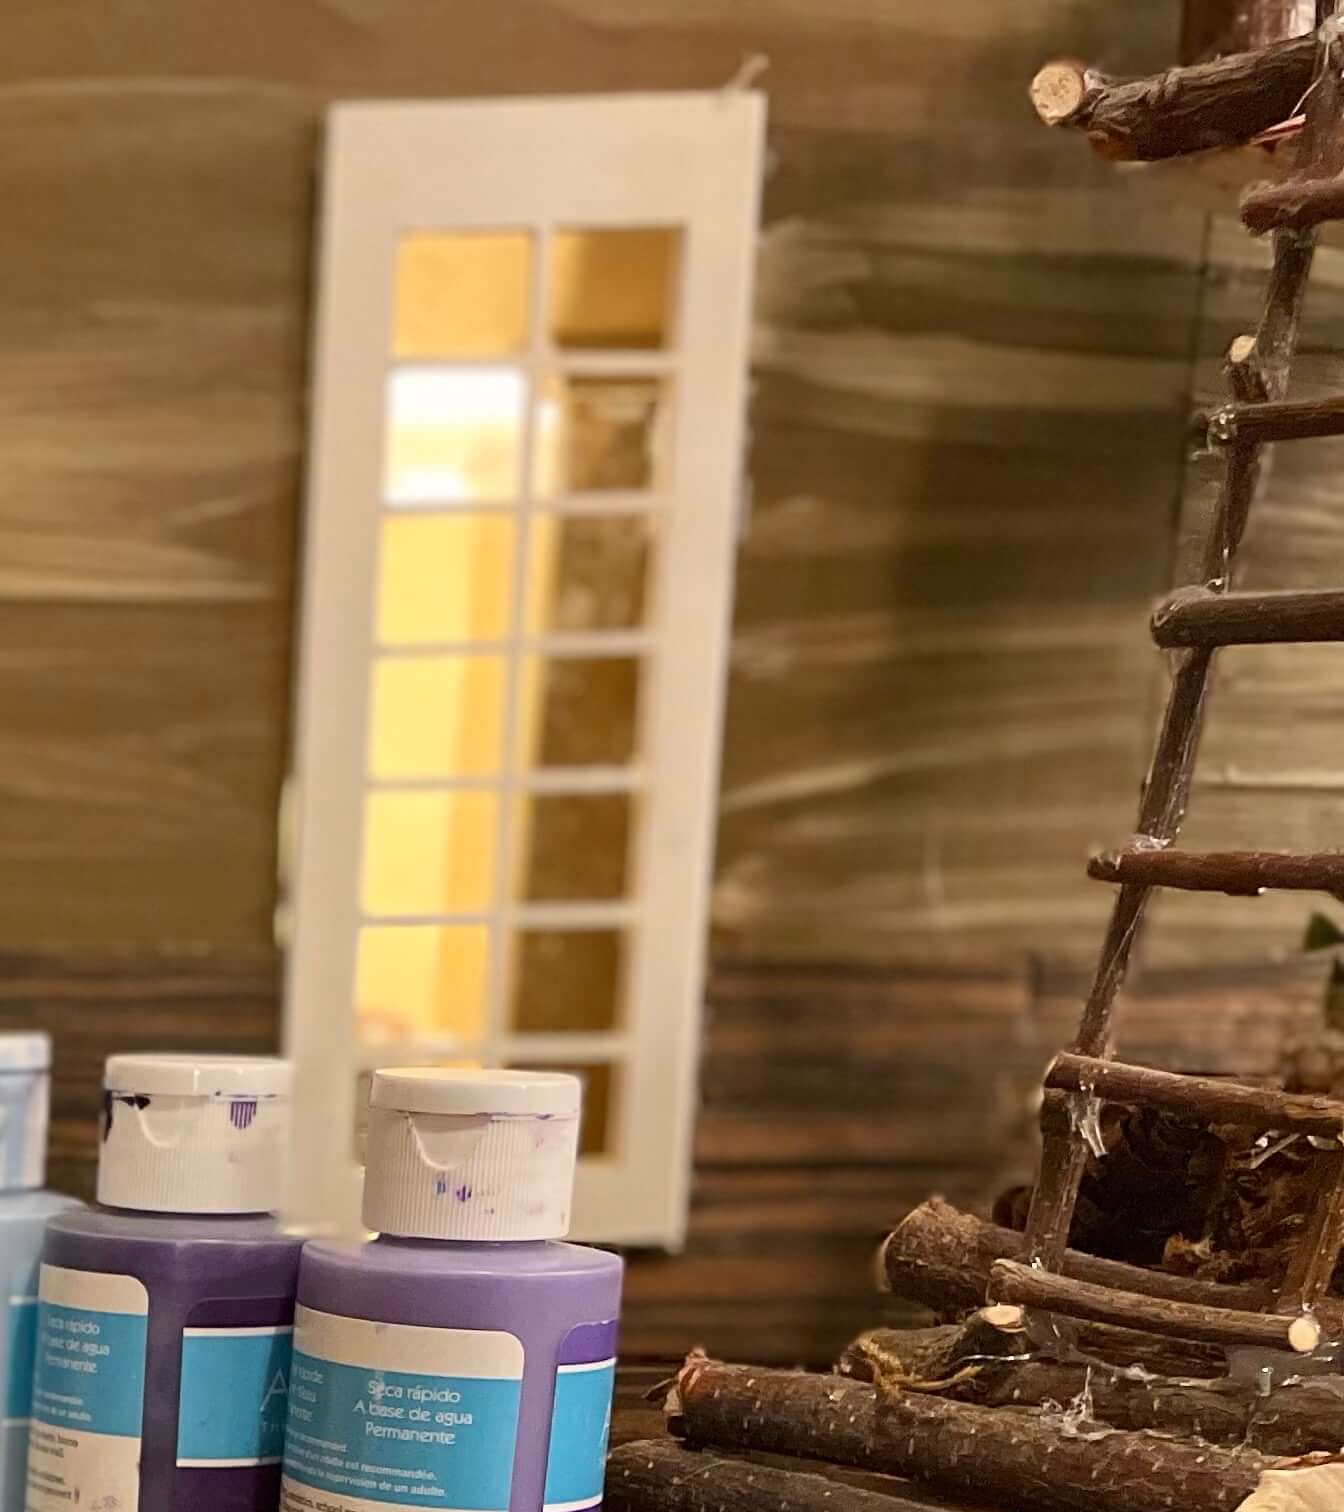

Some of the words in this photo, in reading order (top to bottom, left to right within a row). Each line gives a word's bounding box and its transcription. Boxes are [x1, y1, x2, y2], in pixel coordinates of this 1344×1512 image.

[368, 1378, 404, 1399] Seca
[406, 1383, 461, 1404] rápido
[353, 1399, 367, 1414] A
[368, 1401, 405, 1419] base
[408, 1405, 431, 1422] de
[435, 1409, 473, 1427] agua
[365, 1421, 456, 1446] Permanente
